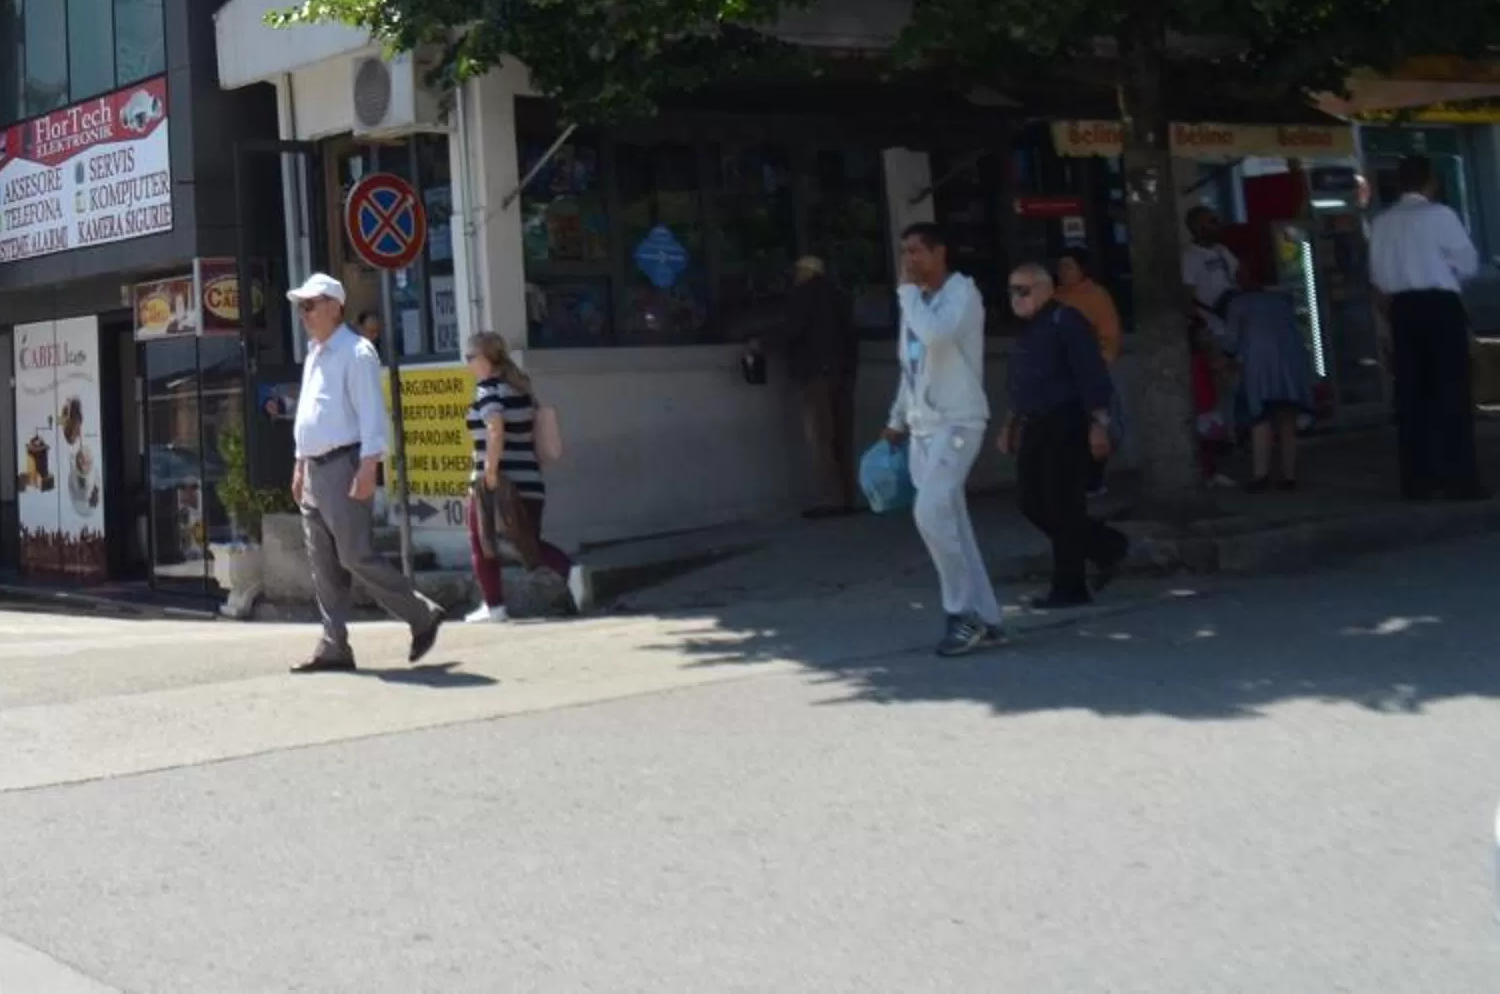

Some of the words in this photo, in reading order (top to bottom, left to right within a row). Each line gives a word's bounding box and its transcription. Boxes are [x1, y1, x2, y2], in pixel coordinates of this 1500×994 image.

[90, 147, 135, 182] SERVIS
[4, 168, 62, 205] AKSESORE
[89, 170, 170, 212] KOMPJUTER
[4, 198, 63, 231] TELEFONA
[78, 214, 125, 244] KAMERA
